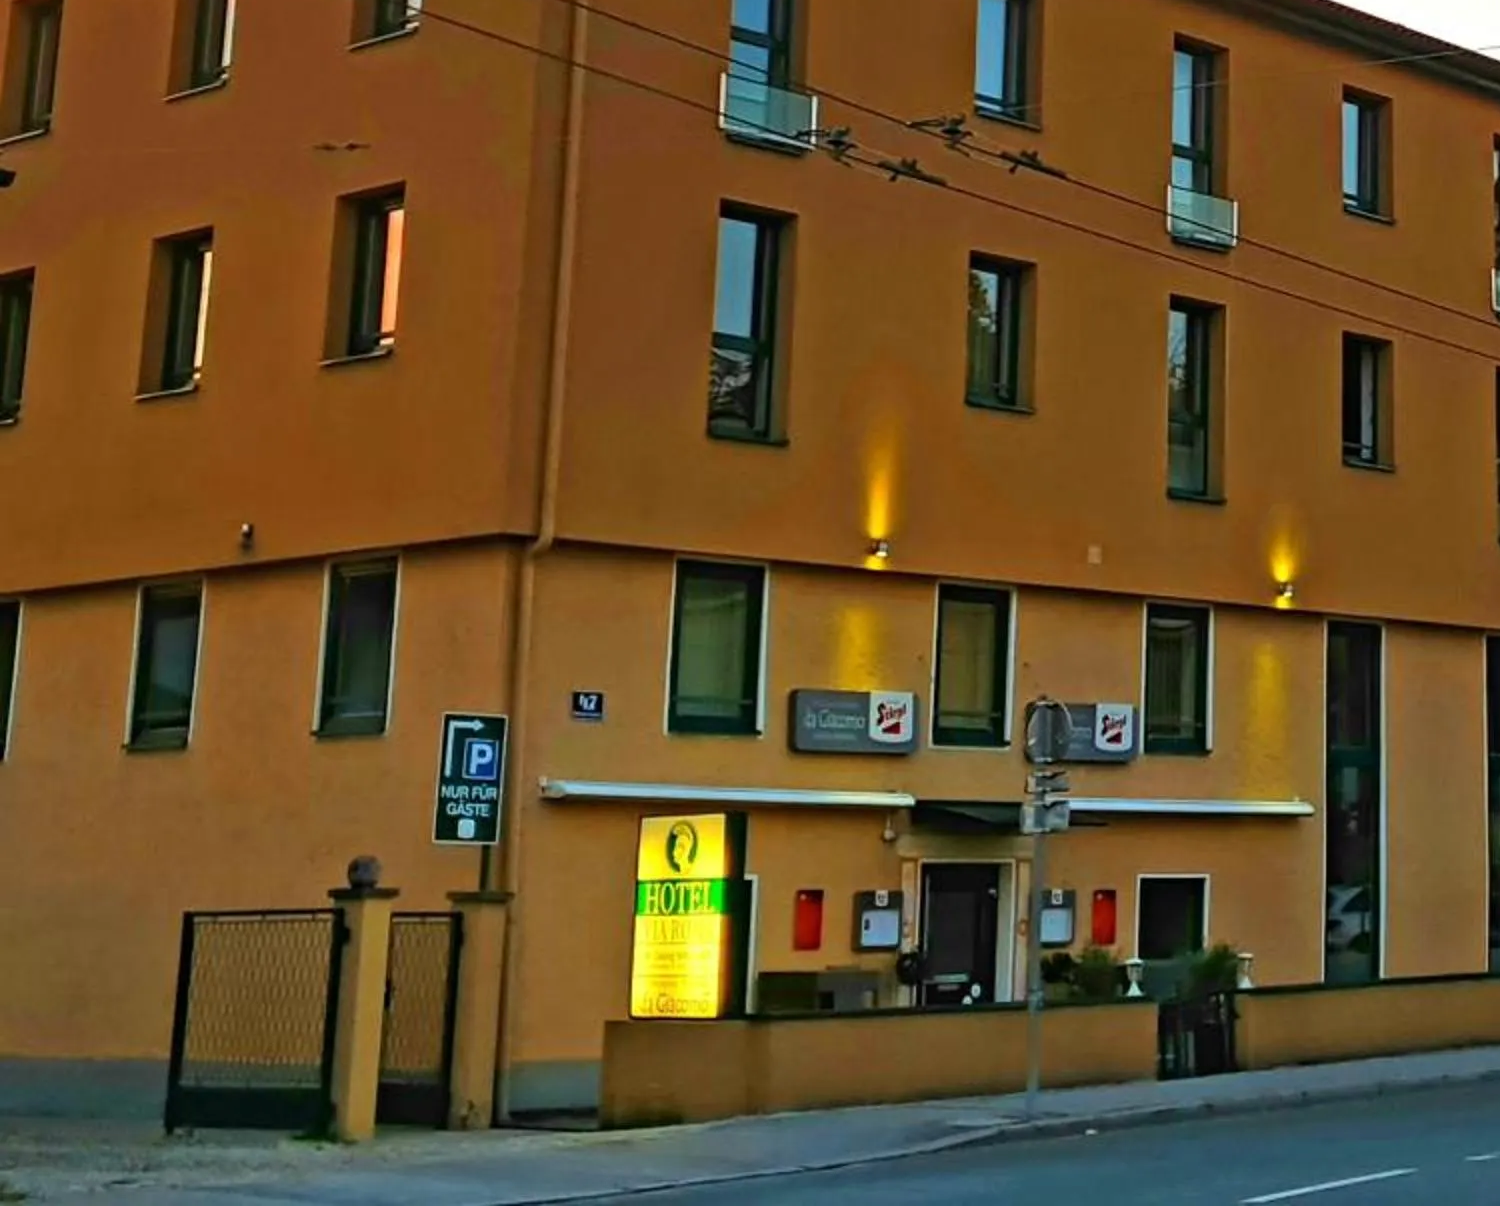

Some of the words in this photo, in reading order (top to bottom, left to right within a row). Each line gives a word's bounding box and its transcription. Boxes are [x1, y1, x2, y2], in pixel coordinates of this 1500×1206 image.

[469, 743, 493, 775] P
[441, 785, 469, 799] NUR
[472, 782, 497, 800] FÜR
[446, 799, 490, 817] GÄSTE
[645, 881, 713, 915] HOTEL
